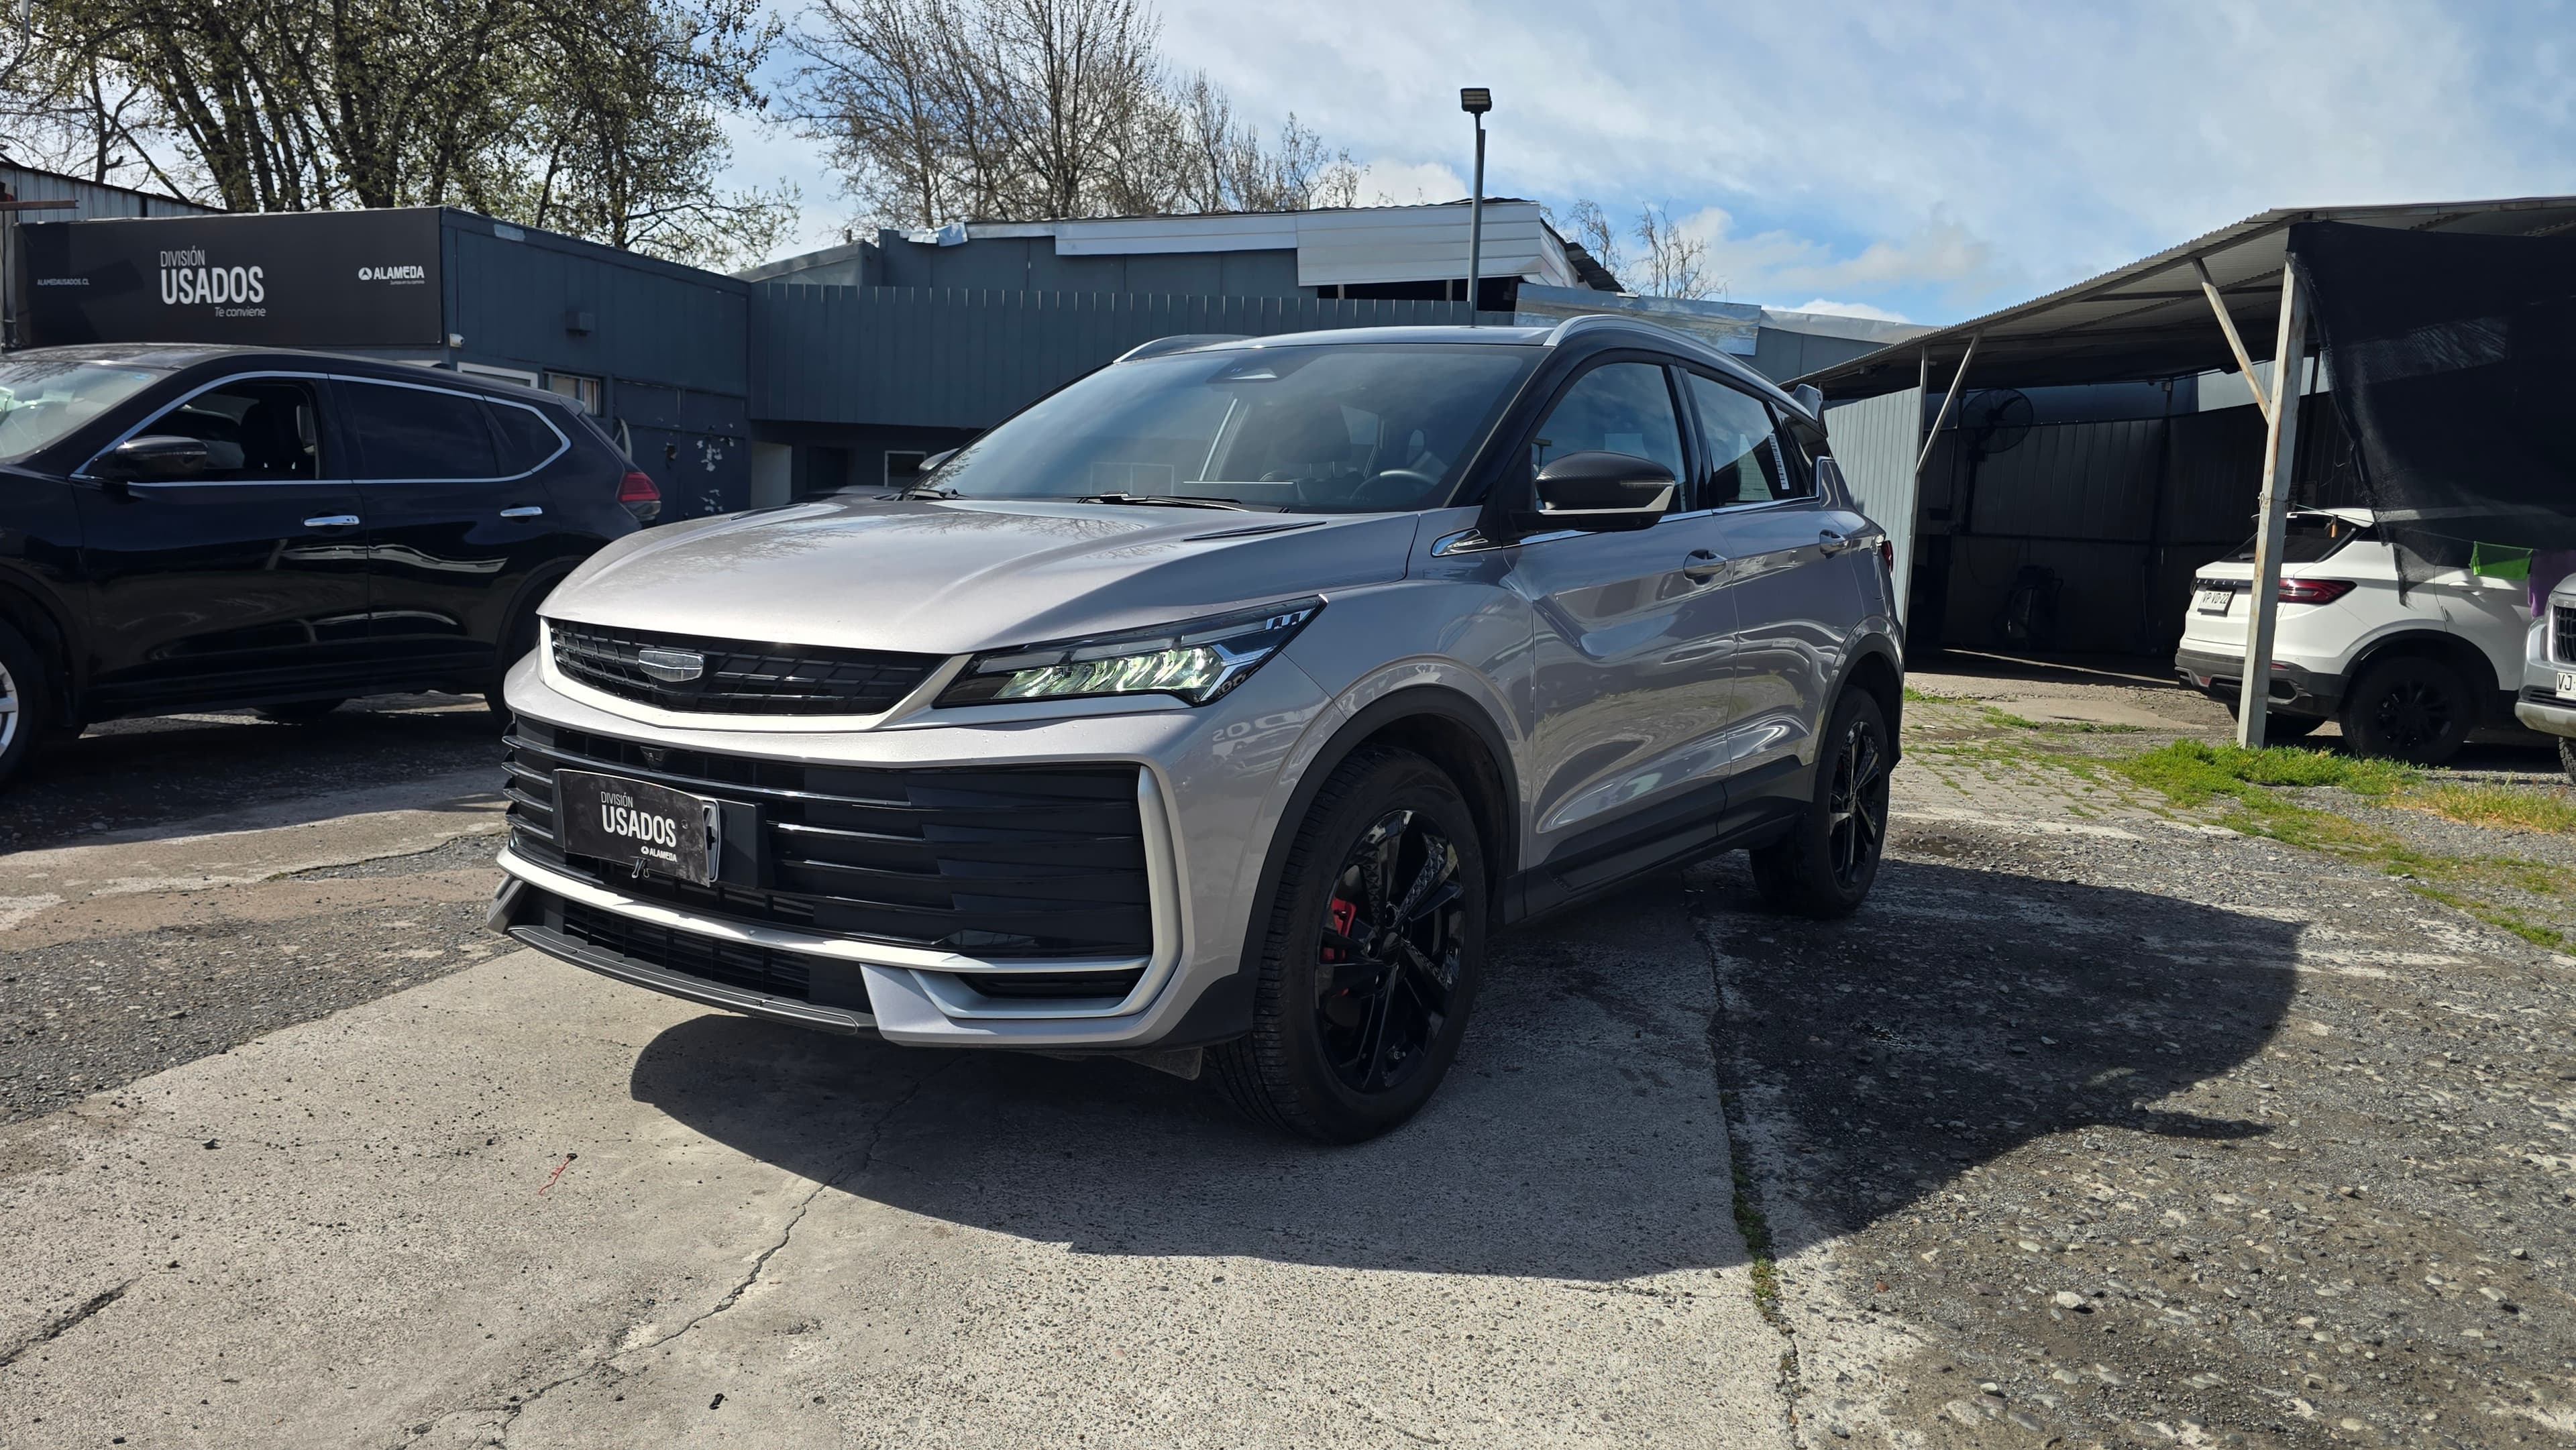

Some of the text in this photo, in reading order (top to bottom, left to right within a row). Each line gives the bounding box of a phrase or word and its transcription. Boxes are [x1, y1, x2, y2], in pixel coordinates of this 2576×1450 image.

[160, 245, 205, 267] DIVISIÓN
[373, 266, 425, 280] ALAMEDA
[161, 266, 264, 305] USADOS
[214, 306, 266, 317] Te conviene
[600, 791, 633, 808] DIVISIÓN
[602, 804, 677, 848] USADOS
[649, 848, 678, 862] ALAMEDA
